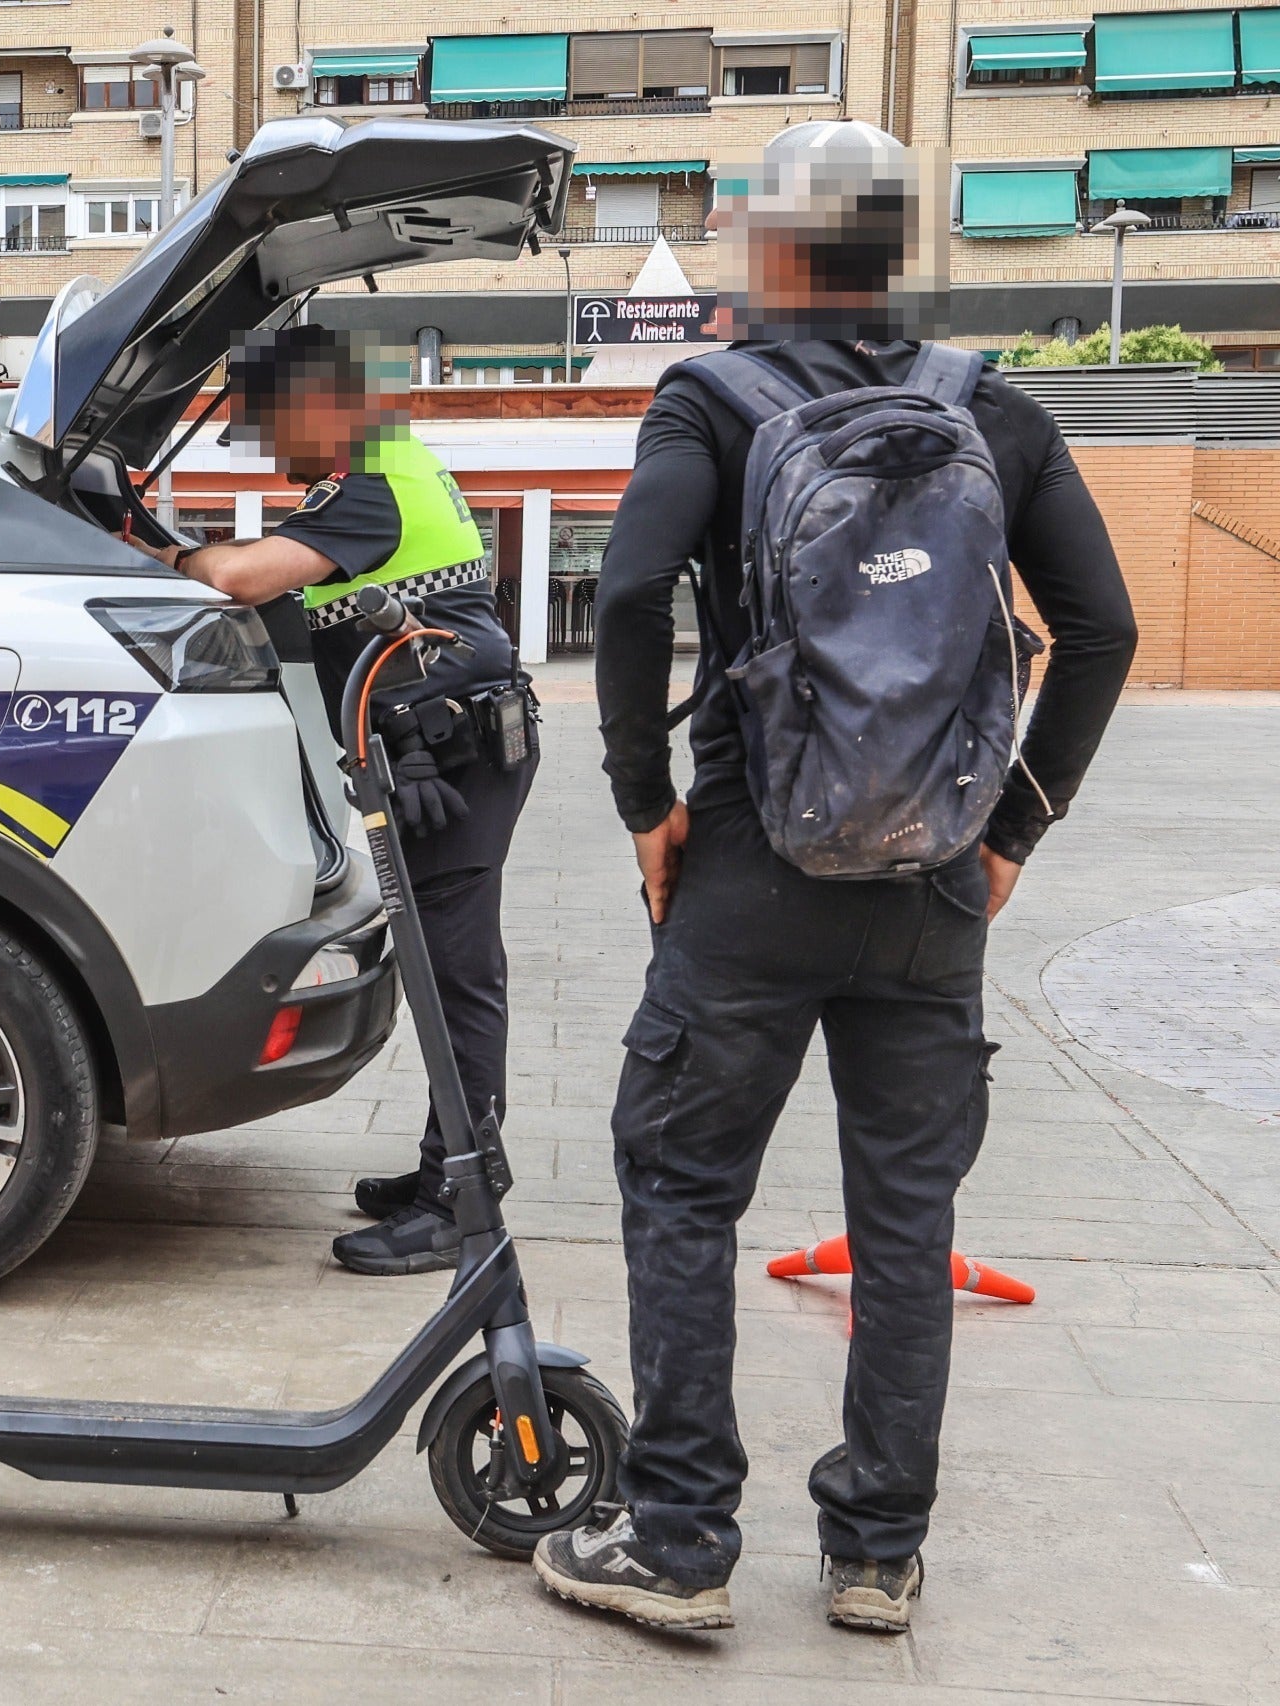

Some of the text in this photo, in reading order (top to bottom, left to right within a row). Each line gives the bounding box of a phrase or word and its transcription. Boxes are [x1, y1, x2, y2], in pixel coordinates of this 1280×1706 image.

[616, 299, 700, 319] Restaurante
[630, 321, 685, 341] Almeria
[874, 550, 904, 563] THE
[859, 560, 905, 575] NORTH
[870, 569, 907, 585] FACE
[54, 697, 136, 735] 112
